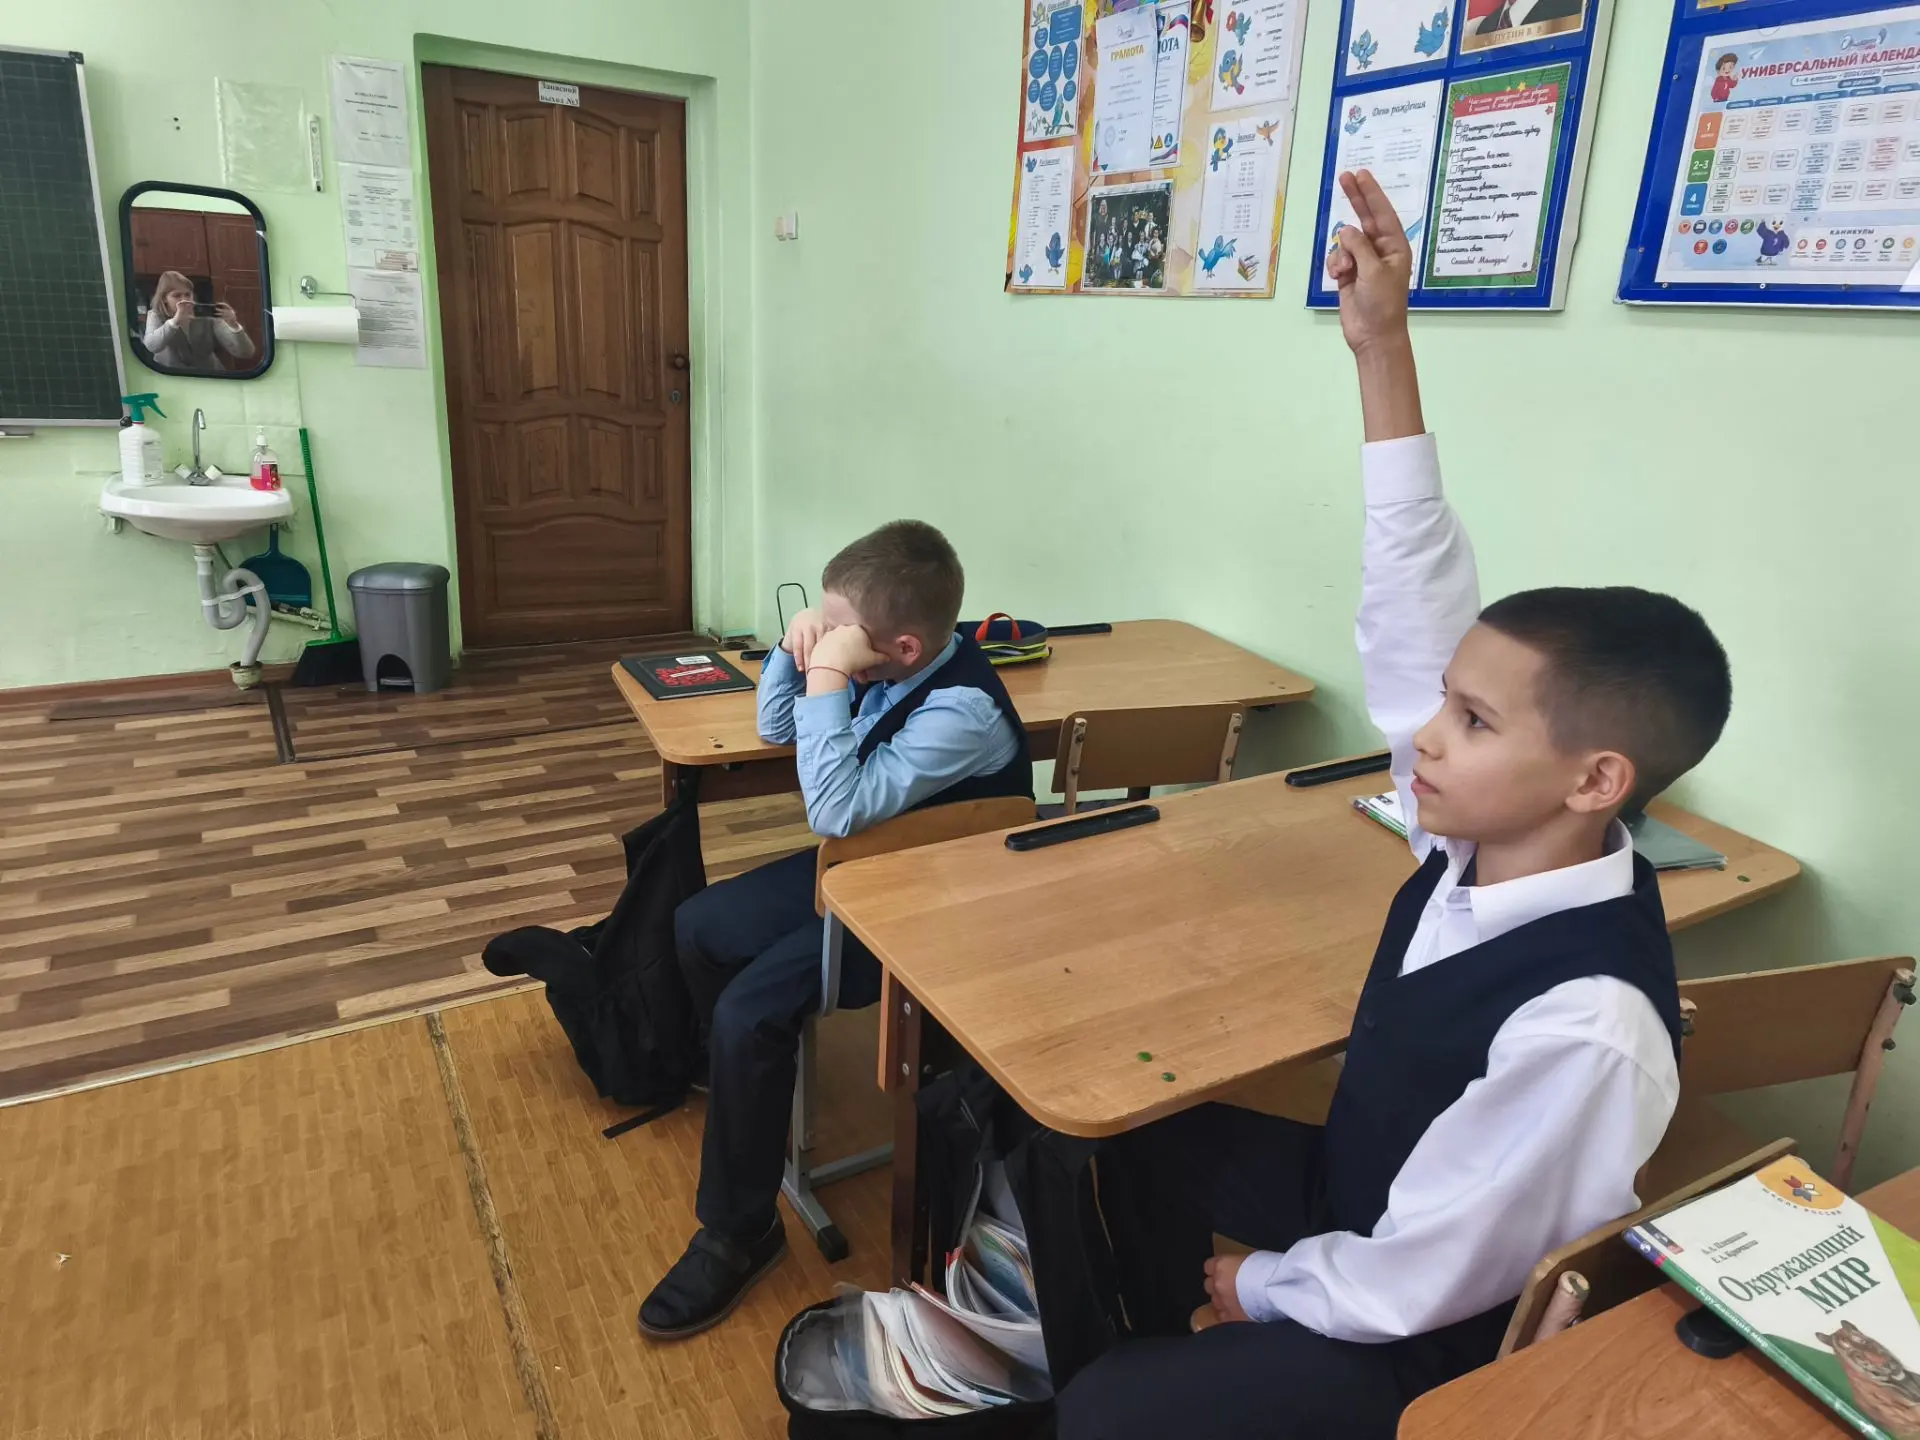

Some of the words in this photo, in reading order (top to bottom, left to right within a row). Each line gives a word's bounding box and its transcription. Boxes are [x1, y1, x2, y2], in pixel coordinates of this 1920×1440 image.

[1110, 44, 1145, 62] ГРАМОТА
[1157, 37, 1179, 54] ОТА
[1741, 52, 1858, 79] УНИВЕРСАЛЬНЫЙ
[1706, 122, 1712, 131] 1
[1693, 160, 1709, 170] 2-3
[1690, 193, 1697, 202] 4
[1829, 228, 1875, 236] КАНИКУЛЫ
[1718, 1223, 1865, 1302] Окружающий
[1795, 1255, 1881, 1315] МИР
